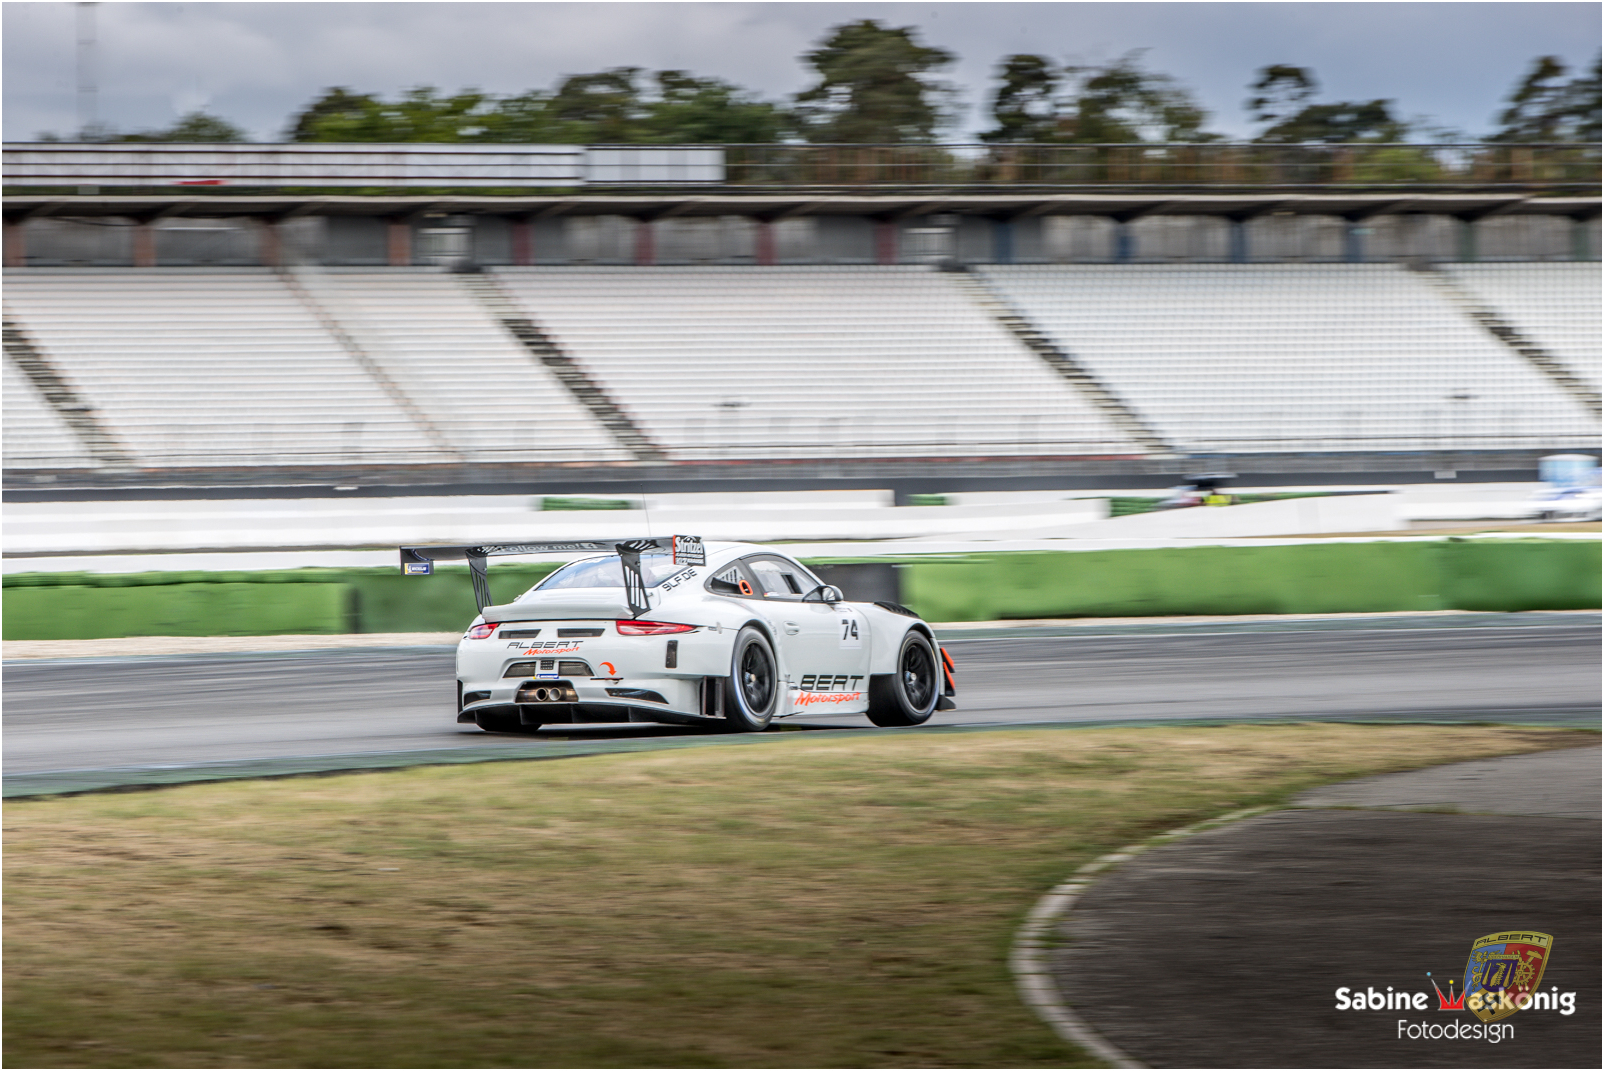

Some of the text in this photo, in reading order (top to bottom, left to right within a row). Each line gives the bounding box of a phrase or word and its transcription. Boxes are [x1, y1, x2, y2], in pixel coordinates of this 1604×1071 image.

[841, 619, 859, 640] 74
[507, 640, 583, 649] ALBERT
[523, 647, 580, 656] Motorsport
[794, 691, 861, 706] Motorsport
